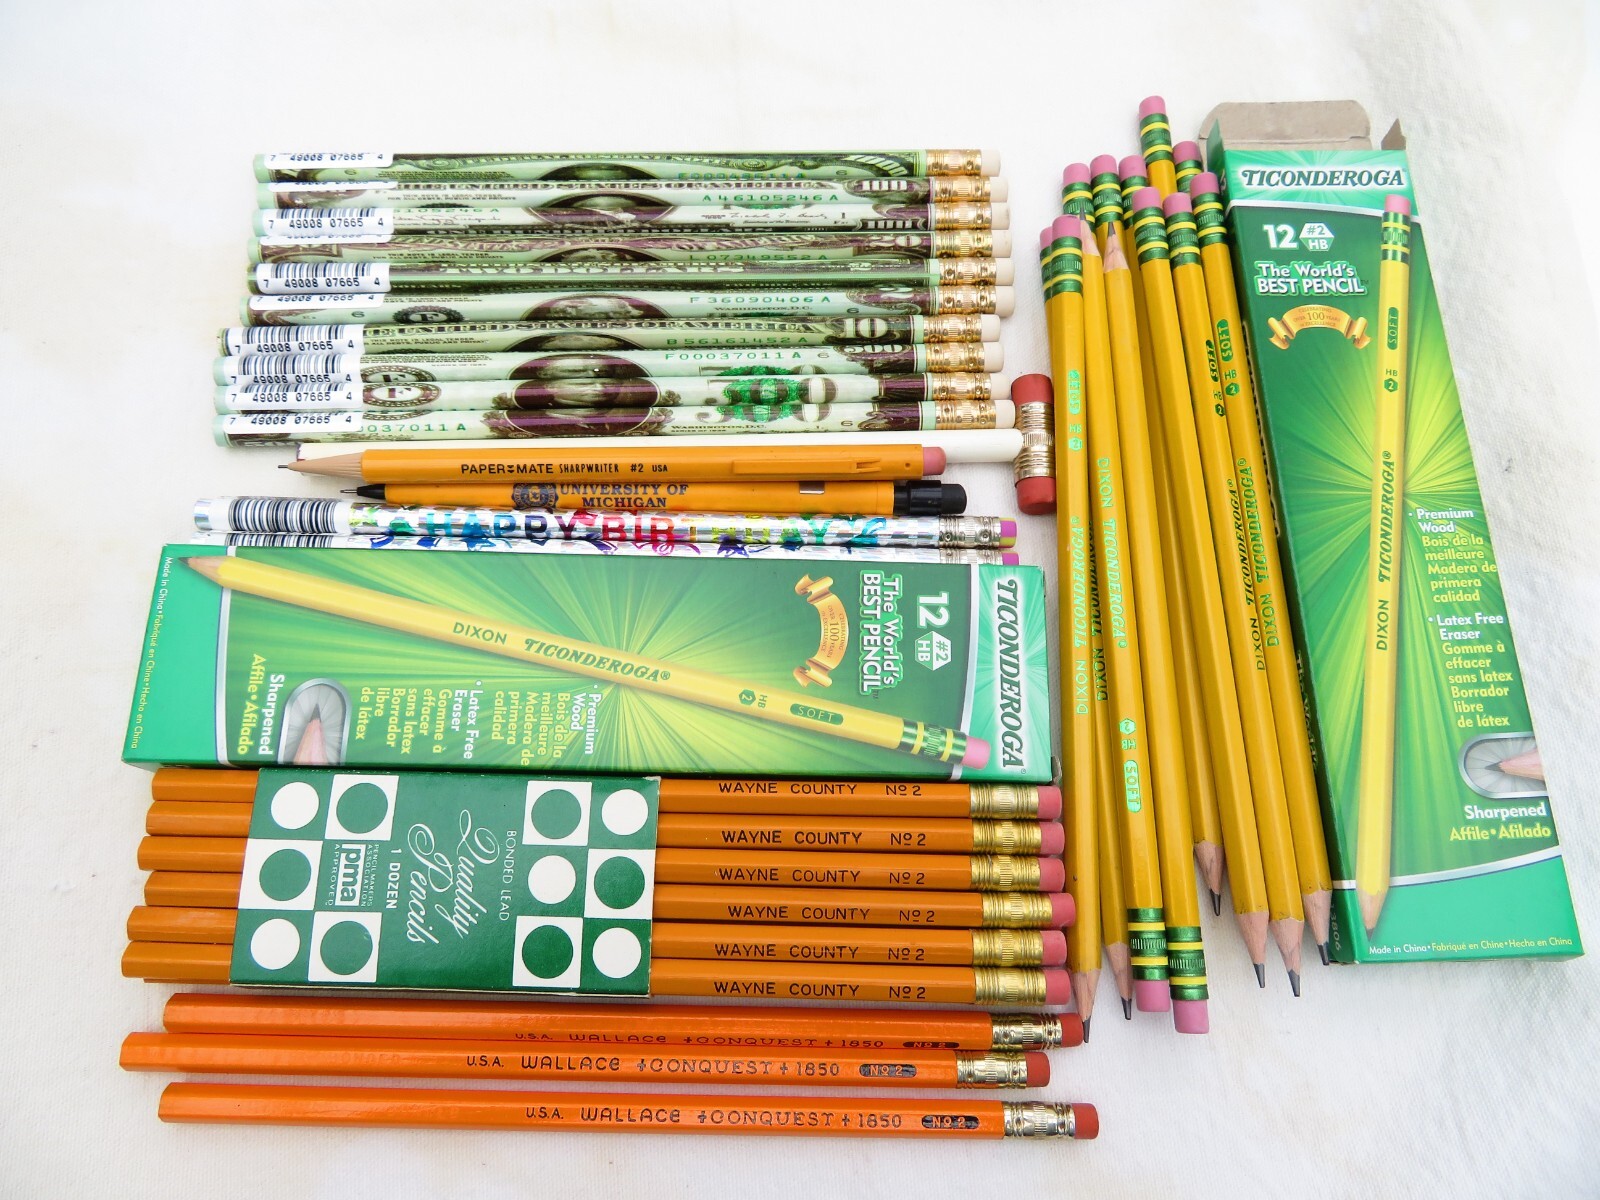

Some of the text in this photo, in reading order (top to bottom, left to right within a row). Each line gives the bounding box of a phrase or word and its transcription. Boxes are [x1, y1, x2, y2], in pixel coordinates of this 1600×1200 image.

[1241, 170, 1404, 186] TICONDEROGA
[289, 218, 363, 228] 49008 07665
[1307, 225, 1325, 235] #2
[1263, 224, 1298, 249] 12
[1309, 239, 1328, 249] HB
[1258, 264, 1354, 277] The World's
[285, 278, 359, 288] 49008 07665
[1258, 278, 1364, 293] BEST PENCIL
[1308, 312, 1324, 320] 100
[1389, 314, 1397, 343] SOFT
[257, 341, 333, 353] 49008 07665
[1219, 326, 1232, 357] SOFT
[253, 375, 330, 383] 49008 07665
[1225, 370, 1236, 380] HB
[253, 392, 330, 402] 49008 07665
[251, 417, 286, 425] 49008
[559, 464, 619, 473] SHARPWRITER
[630, 464, 644, 472] #2
[653, 464, 667, 472] USA
[560, 484, 688, 495] UNIVERSITY OF
[1098, 457, 1113, 507] DIXON
[582, 498, 666, 507] MICHIGAN
[1416, 508, 1474, 520] Premium
[1419, 522, 1455, 533] Wood
[1422, 535, 1483, 547] Bois de la
[1425, 550, 1484, 561] meilleure
[1427, 563, 1497, 574] Madera de
[1431, 578, 1481, 591] primera
[863, 574, 880, 619] BEST
[1433, 590, 1480, 603] calidad
[918, 592, 950, 627] 12
[1437, 613, 1504, 626] Latex Free
[1260, 594, 1279, 646] DIXON
[1377, 599, 1389, 651] DIXON
[453, 622, 507, 645] DIXON
[830, 622, 839, 641] 100
[883, 578, 900, 685] The World's
[1440, 629, 1480, 640] Eraser
[131, 557, 172, 748] Made China
[916, 640, 931, 662] HB
[935, 641, 948, 662] #2
[1250, 618, 1265, 670] DIXON
[1442, 643, 1492, 654] Gomme
[1446, 656, 1491, 669] effacer
[1094, 649, 1108, 700] DIXON
[1449, 671, 1513, 684] sans latex
[1076, 660, 1088, 714] DIXON
[1451, 686, 1509, 698] Borrador
[374, 688, 390, 717] libre
[419, 689, 436, 736] effacer
[451, 690, 467, 731] Eraser
[571, 693, 586, 730] Wood
[1454, 700, 1483, 713] libre
[259, 675, 285, 755] Sharpened
[356, 687, 374, 740] de látex
[387, 688, 406, 747] Borrador
[401, 688, 417, 754] sans latex
[434, 689, 452, 741] Gomme
[492, 691, 507, 740] calidad
[507, 691, 522, 745] primera
[798, 706, 834, 723] SOFT
[1457, 715, 1510, 728] de látex
[464, 690, 483, 759] Latex Free
[521, 692, 539, 766] Madera de
[538, 693, 553, 755] meilleure
[553, 693, 571, 758] Bois de la
[585, 694, 601, 755] Premium
[719, 783, 857, 794] WAYNE COUNTY
[1126, 767, 1139, 804] SOFT
[1464, 802, 1547, 820] Sharpened
[722, 830, 862, 844] WAYNE COUNTY
[328, 844, 340, 905] APPROVED
[340, 848, 361, 901] pma
[361, 845, 373, 906] ASSOCIATION
[407, 823, 454, 943] Pencils
[434, 810, 500, 939] Quality
[499, 830, 517, 921] BONDED LEAD
[719, 869, 860, 882] WAYNE COUNTY
[386, 863, 401, 908] DOZEN
[728, 906, 869, 920] WAYNE COUNTY
[715, 944, 859, 958] WAYNE COUNTY
[1369, 946, 1391, 955] Made
[1469, 942, 1478, 950] en
[1549, 938, 1572, 946] China
[714, 982, 859, 996] WAYNE COUNTY
[841, 1040, 883, 1048] 1850
[466, 1053, 503, 1066] U.S.A.
[796, 1063, 840, 1076] 1850
[526, 1106, 563, 1119] U.S.A.
[859, 1113, 902, 1128] 1850
